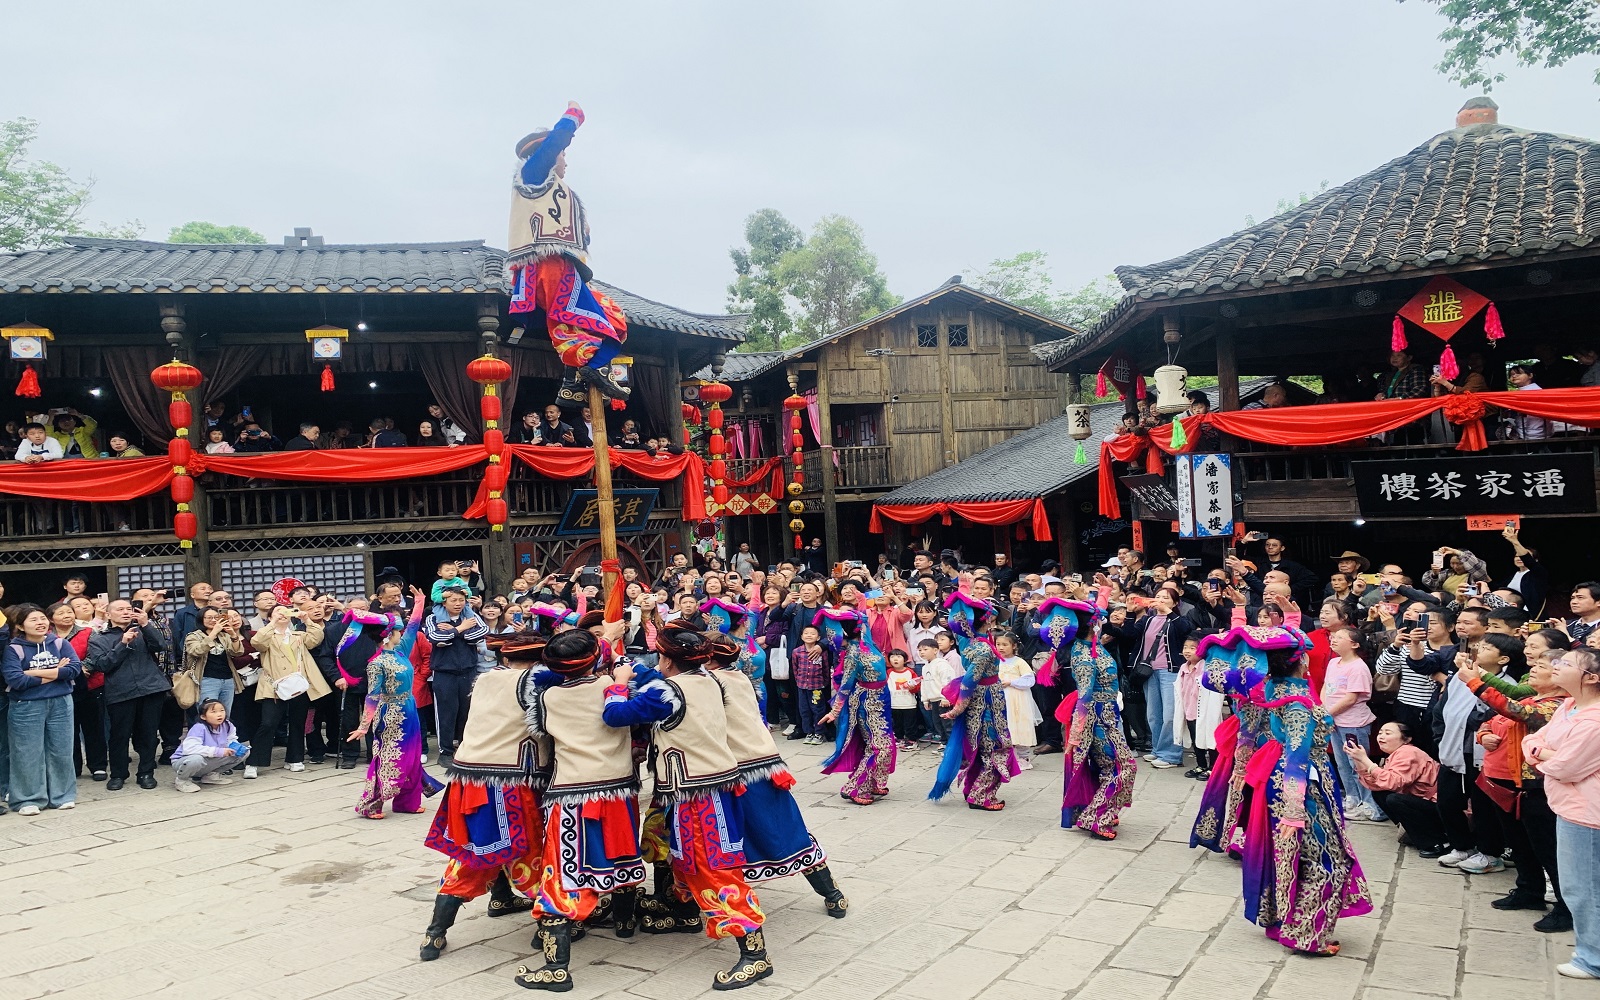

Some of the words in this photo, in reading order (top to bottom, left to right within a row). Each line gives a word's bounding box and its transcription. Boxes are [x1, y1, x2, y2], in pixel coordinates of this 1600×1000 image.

[1074, 410, 1091, 428] 茶
[1205, 461, 1222, 531] 潘家茶樓
[1379, 468, 1566, 502] 潘家茶樓
[573, 497, 643, 527] 其居
[29, 659, 60, 668] Roots
